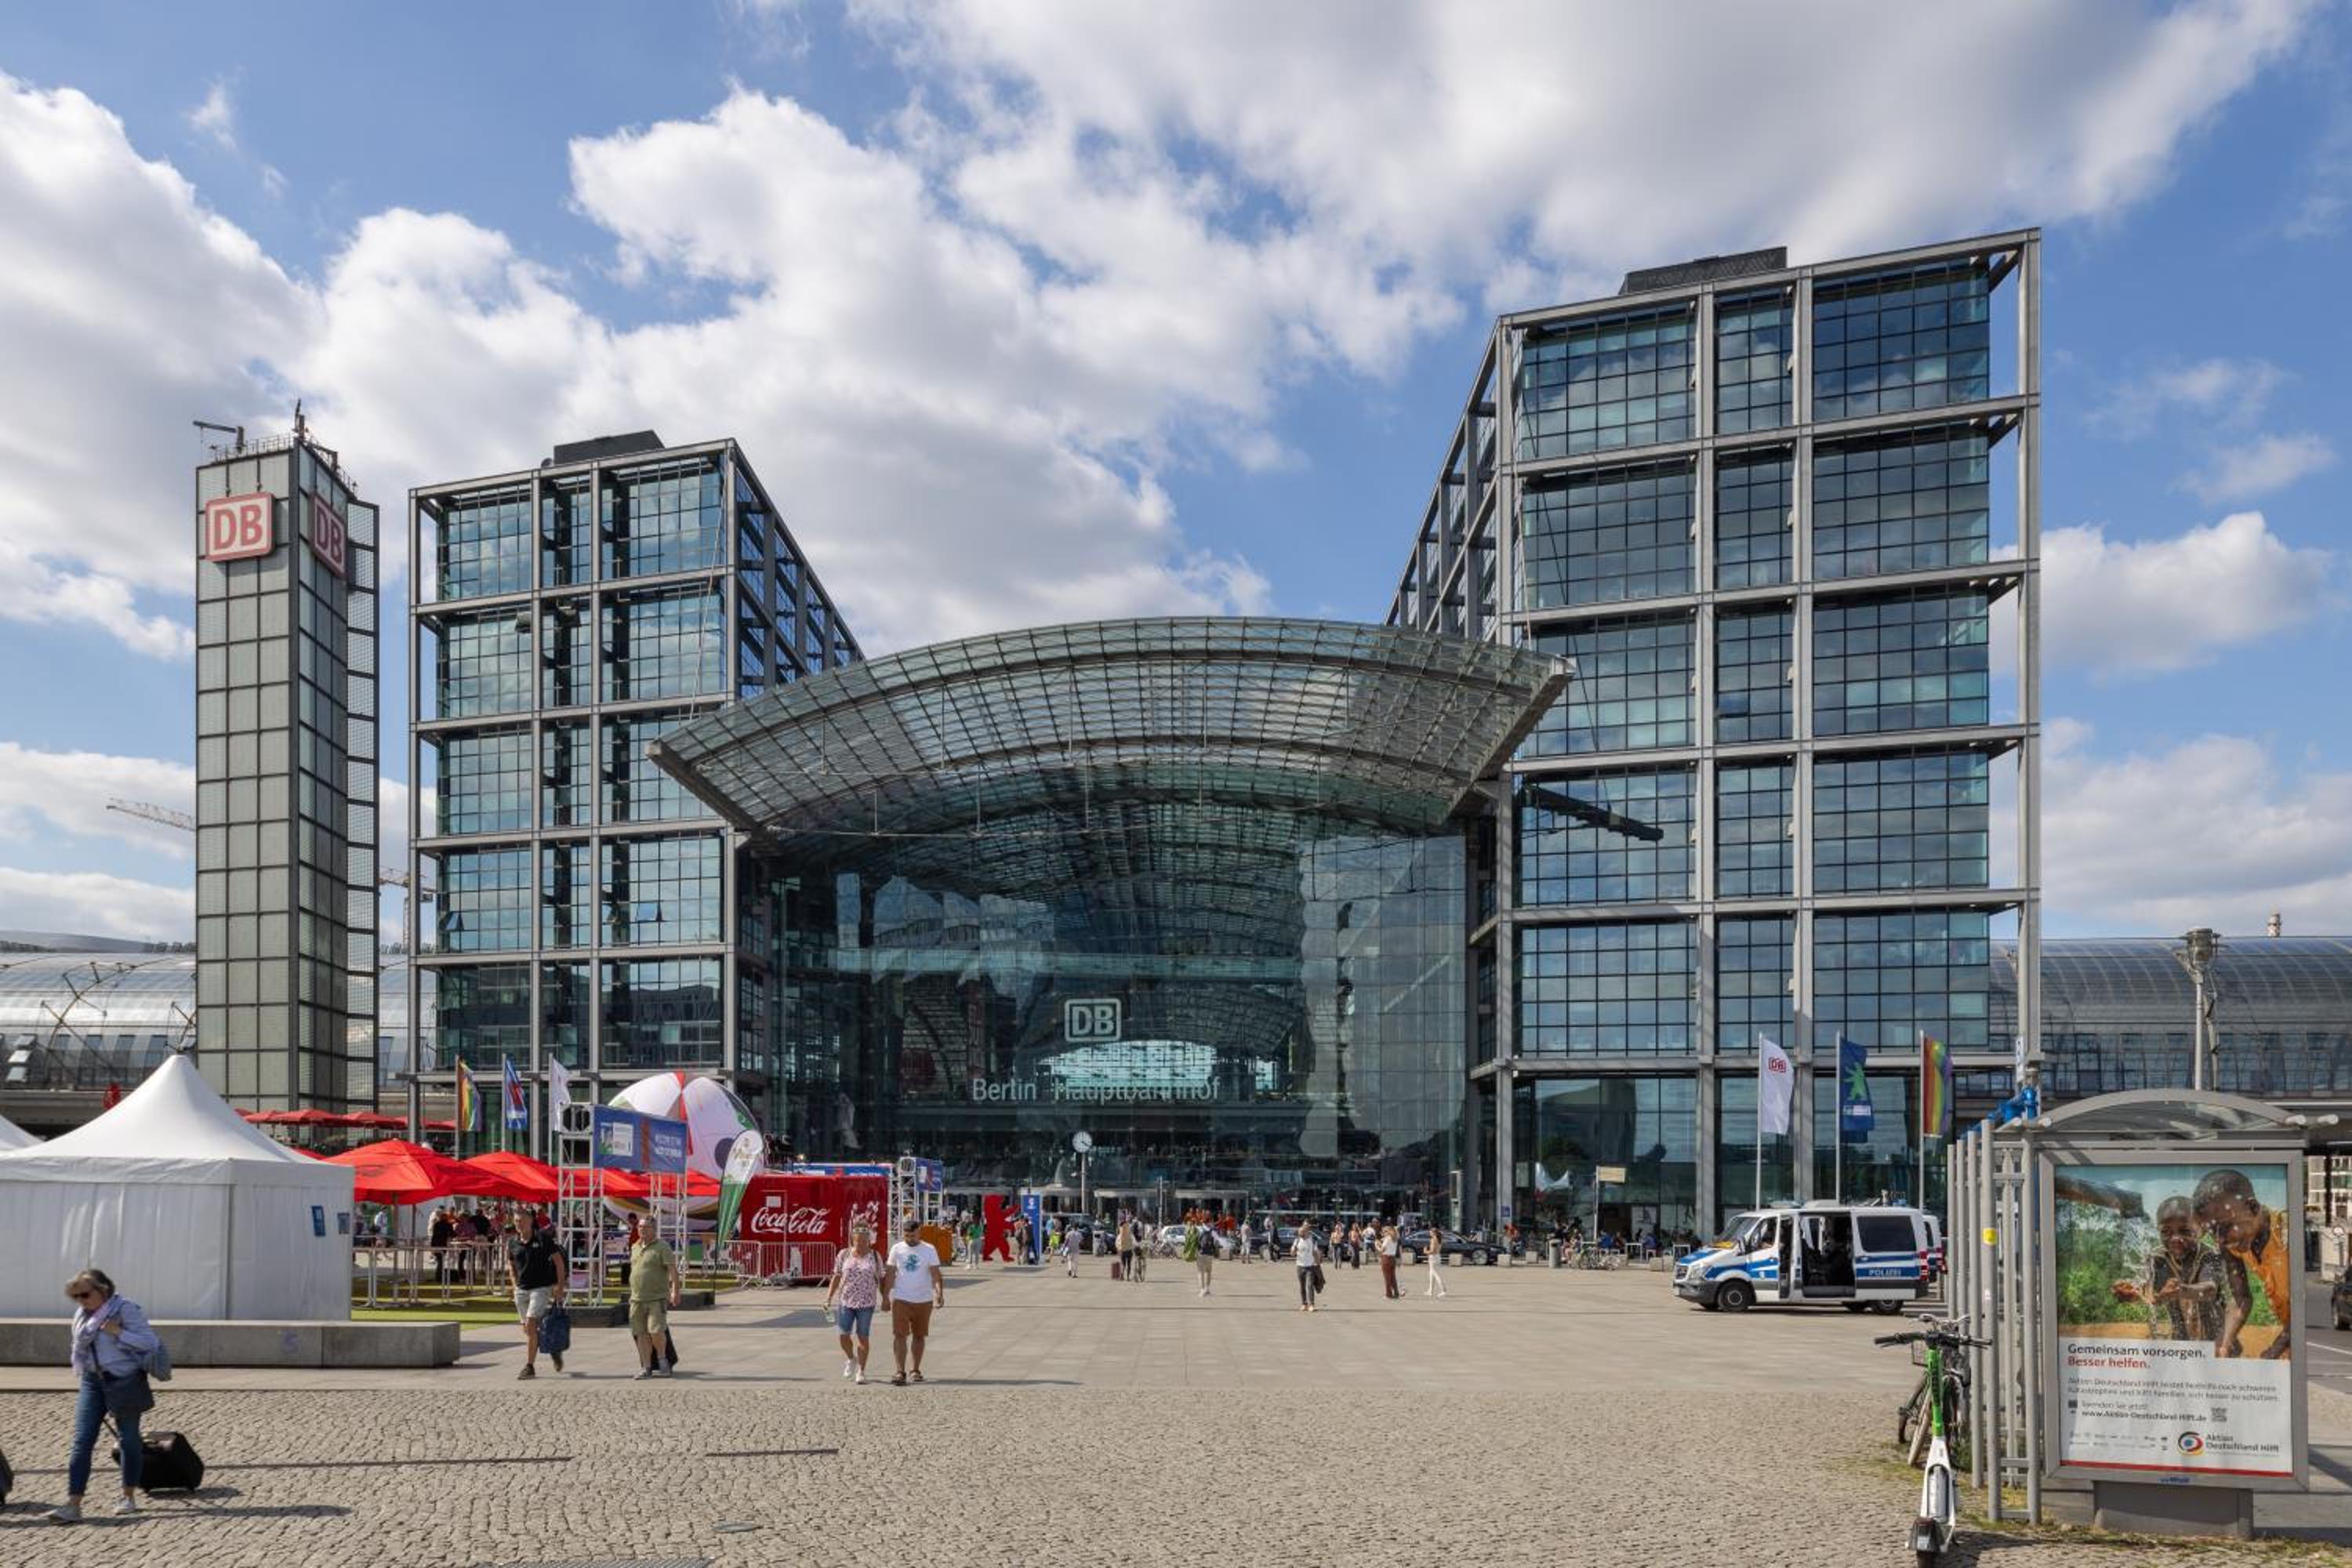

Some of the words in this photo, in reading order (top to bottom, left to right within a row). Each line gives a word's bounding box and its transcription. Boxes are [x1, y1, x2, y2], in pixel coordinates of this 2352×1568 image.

[214, 504, 263, 550] DB
[317, 506, 343, 564] DB
[1072, 1005, 1113, 1035] DB
[973, 1078, 1036, 1101] Berlin
[2067, 1343, 2140, 1356] Gemeinsam
[2143, 1347, 2205, 1359] vorsorgen.
[2067, 1356, 2106, 1367] Besser
[2109, 1356, 2151, 1368] helfen.
[2205, 1442, 2259, 1451] Deutschland
